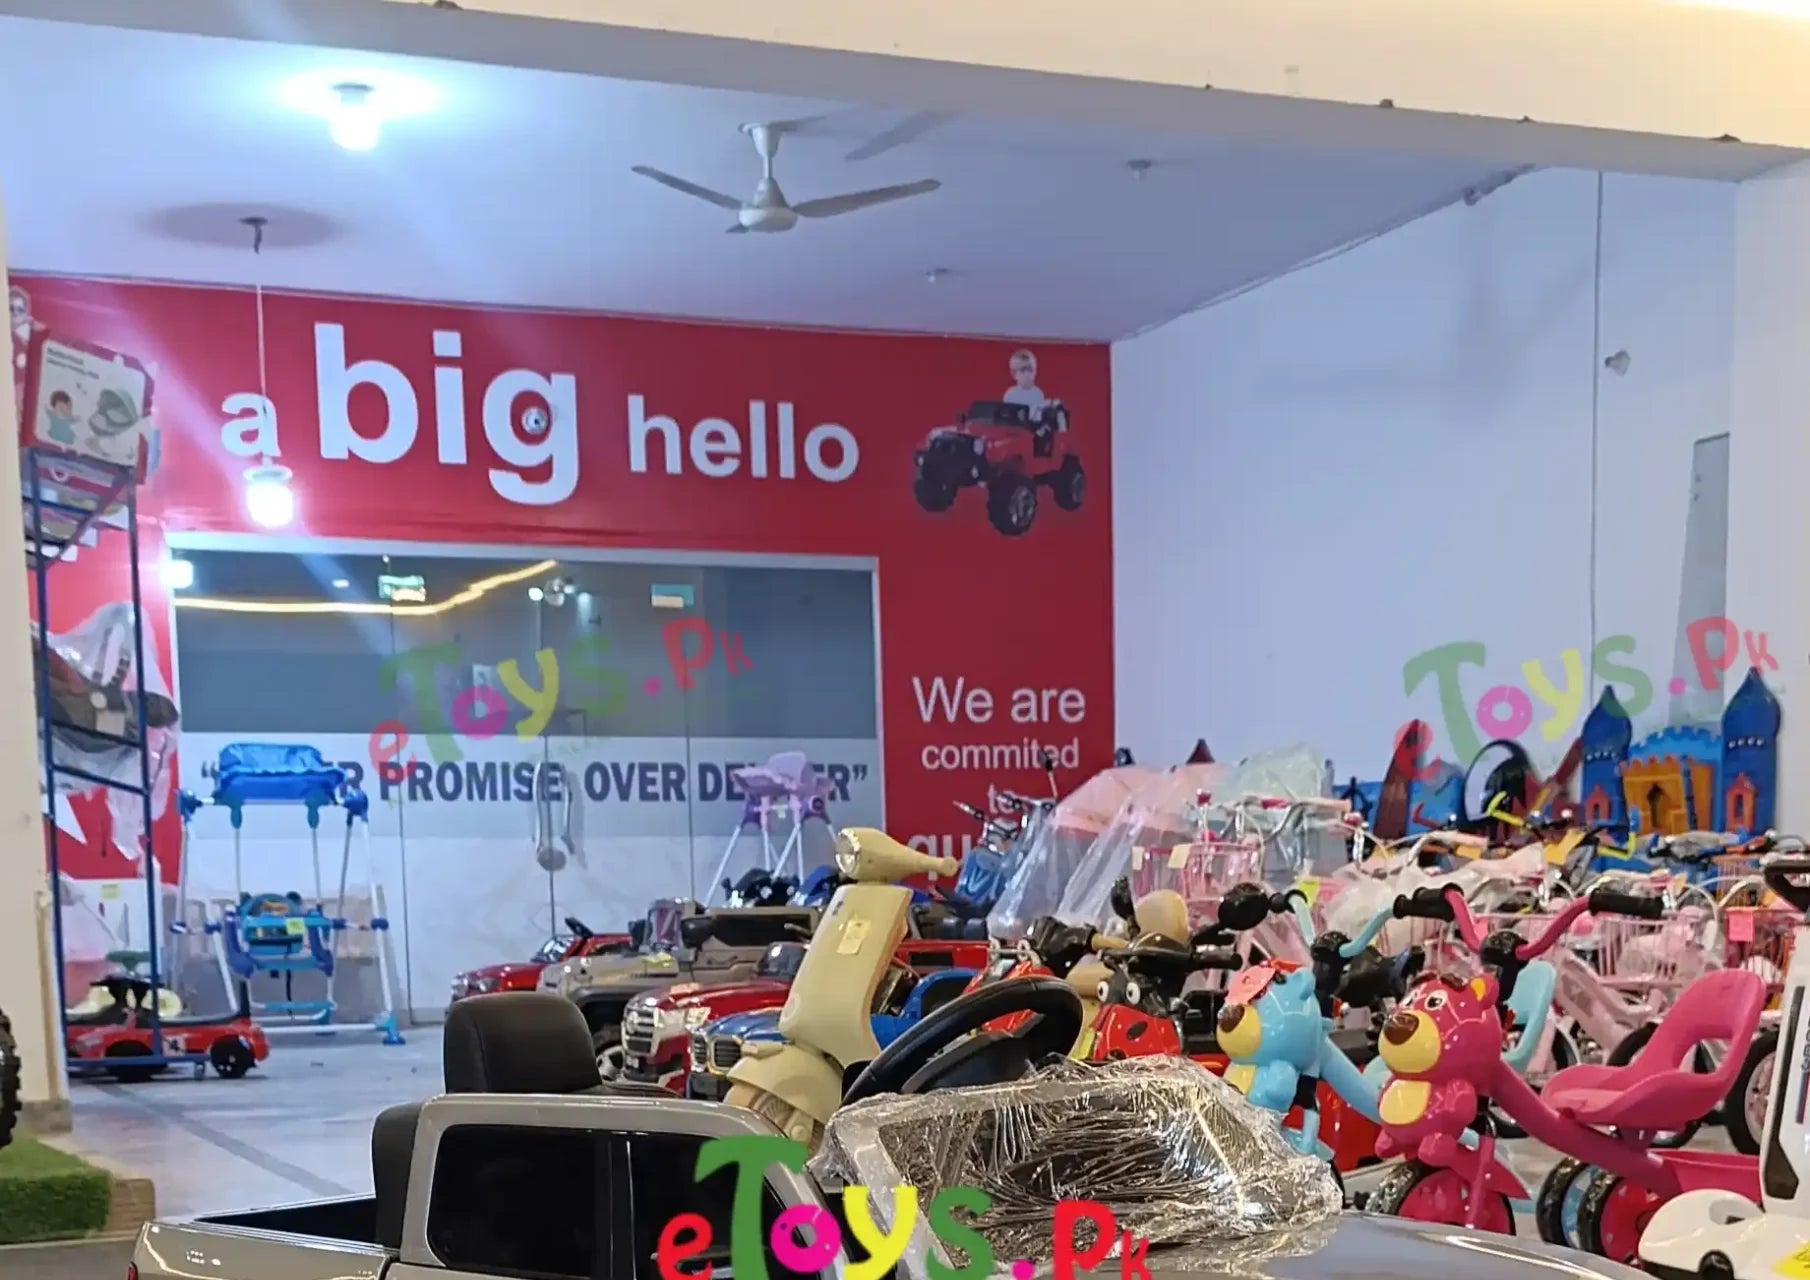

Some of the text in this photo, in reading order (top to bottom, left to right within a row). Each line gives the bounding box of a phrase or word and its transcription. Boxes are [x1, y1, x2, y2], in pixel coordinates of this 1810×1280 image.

[220, 322, 860, 505] a big hello
[912, 676, 1086, 724] We are
[921, 737, 1080, 770] commited
[379, 761, 563, 802] PROMISE
[584, 761, 687, 802] OVER
